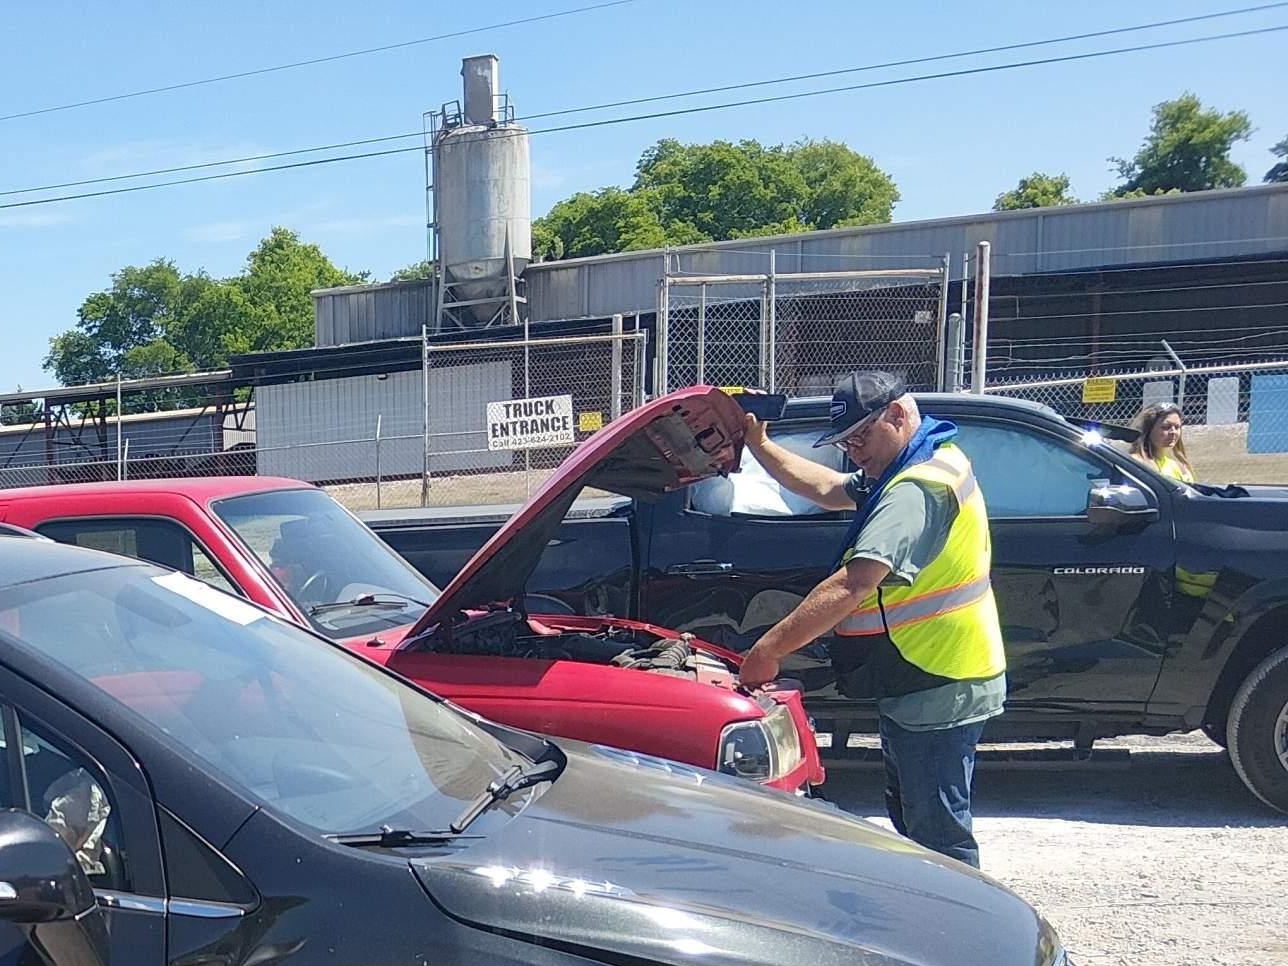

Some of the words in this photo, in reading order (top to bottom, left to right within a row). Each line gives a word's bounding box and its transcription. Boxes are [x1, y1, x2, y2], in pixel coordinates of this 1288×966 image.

[503, 399, 555, 418] TRUCK
[491, 416, 569, 438] ENTRANCE
[492, 439, 510, 448] Call
[1053, 566, 1145, 575] COLORADO
